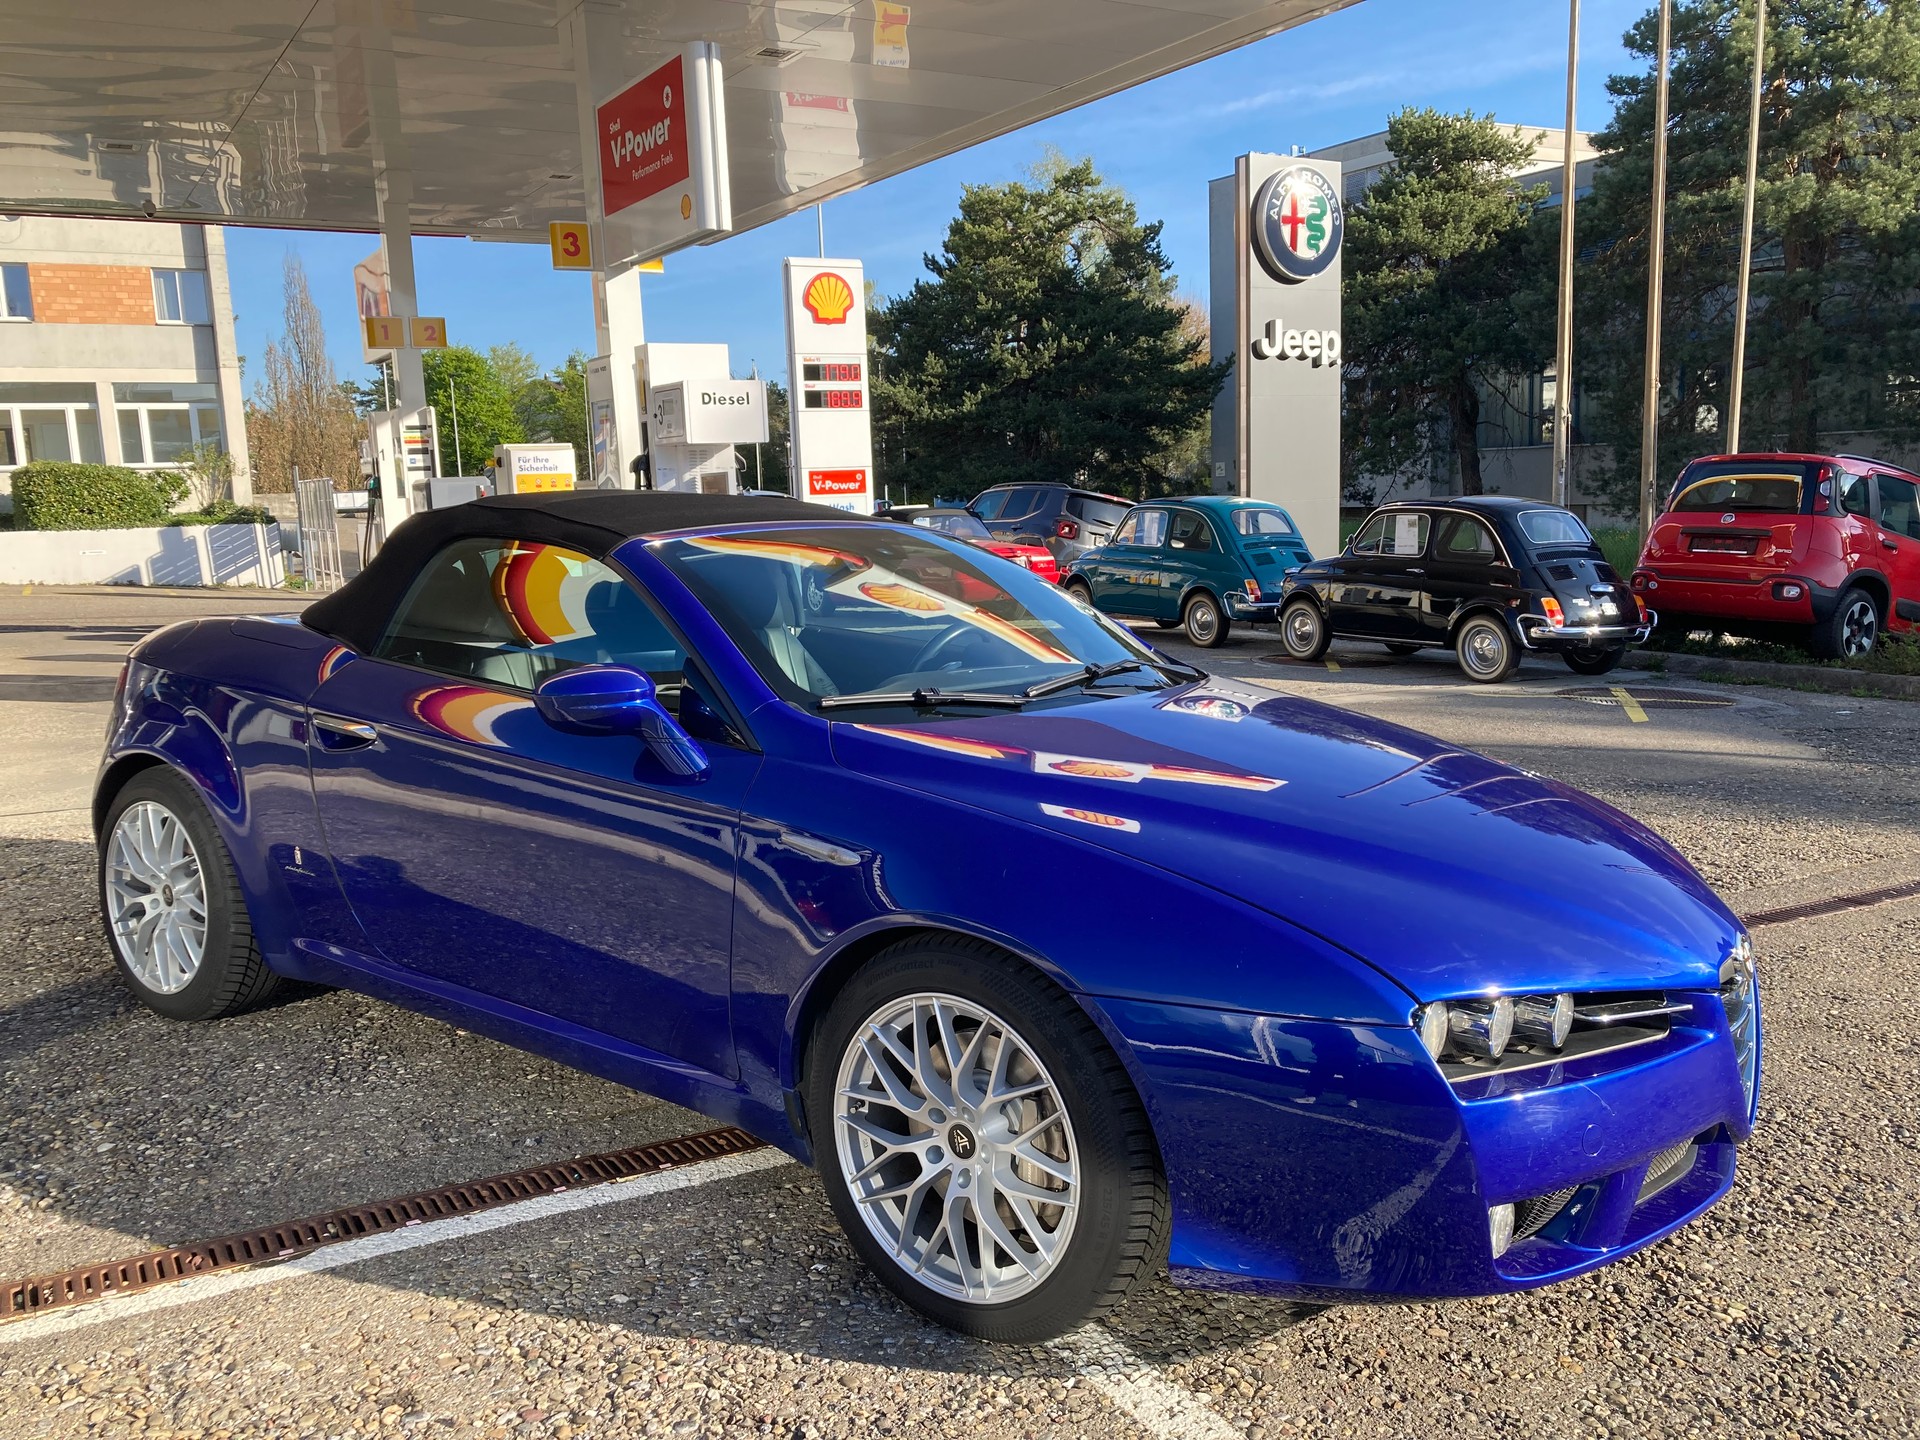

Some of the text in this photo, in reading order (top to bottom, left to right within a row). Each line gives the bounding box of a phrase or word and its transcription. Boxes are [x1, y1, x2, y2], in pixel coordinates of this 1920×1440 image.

[609, 118, 620, 134] Shell
[610, 116, 671, 168] V-Power
[632, 150, 673, 181] Performance Fuels
[1302, 170, 1341, 226] ROMEO
[562, 231, 581, 257] 3
[380, 324, 389, 341] 1
[423, 325, 437, 341] 2
[1261, 319, 1342, 366] Jeep
[701, 391, 750, 406] Diesel
[657, 404, 664, 425] 3
[518, 464, 559, 472] Sicherheit
[813, 480, 860, 491] V-Power
